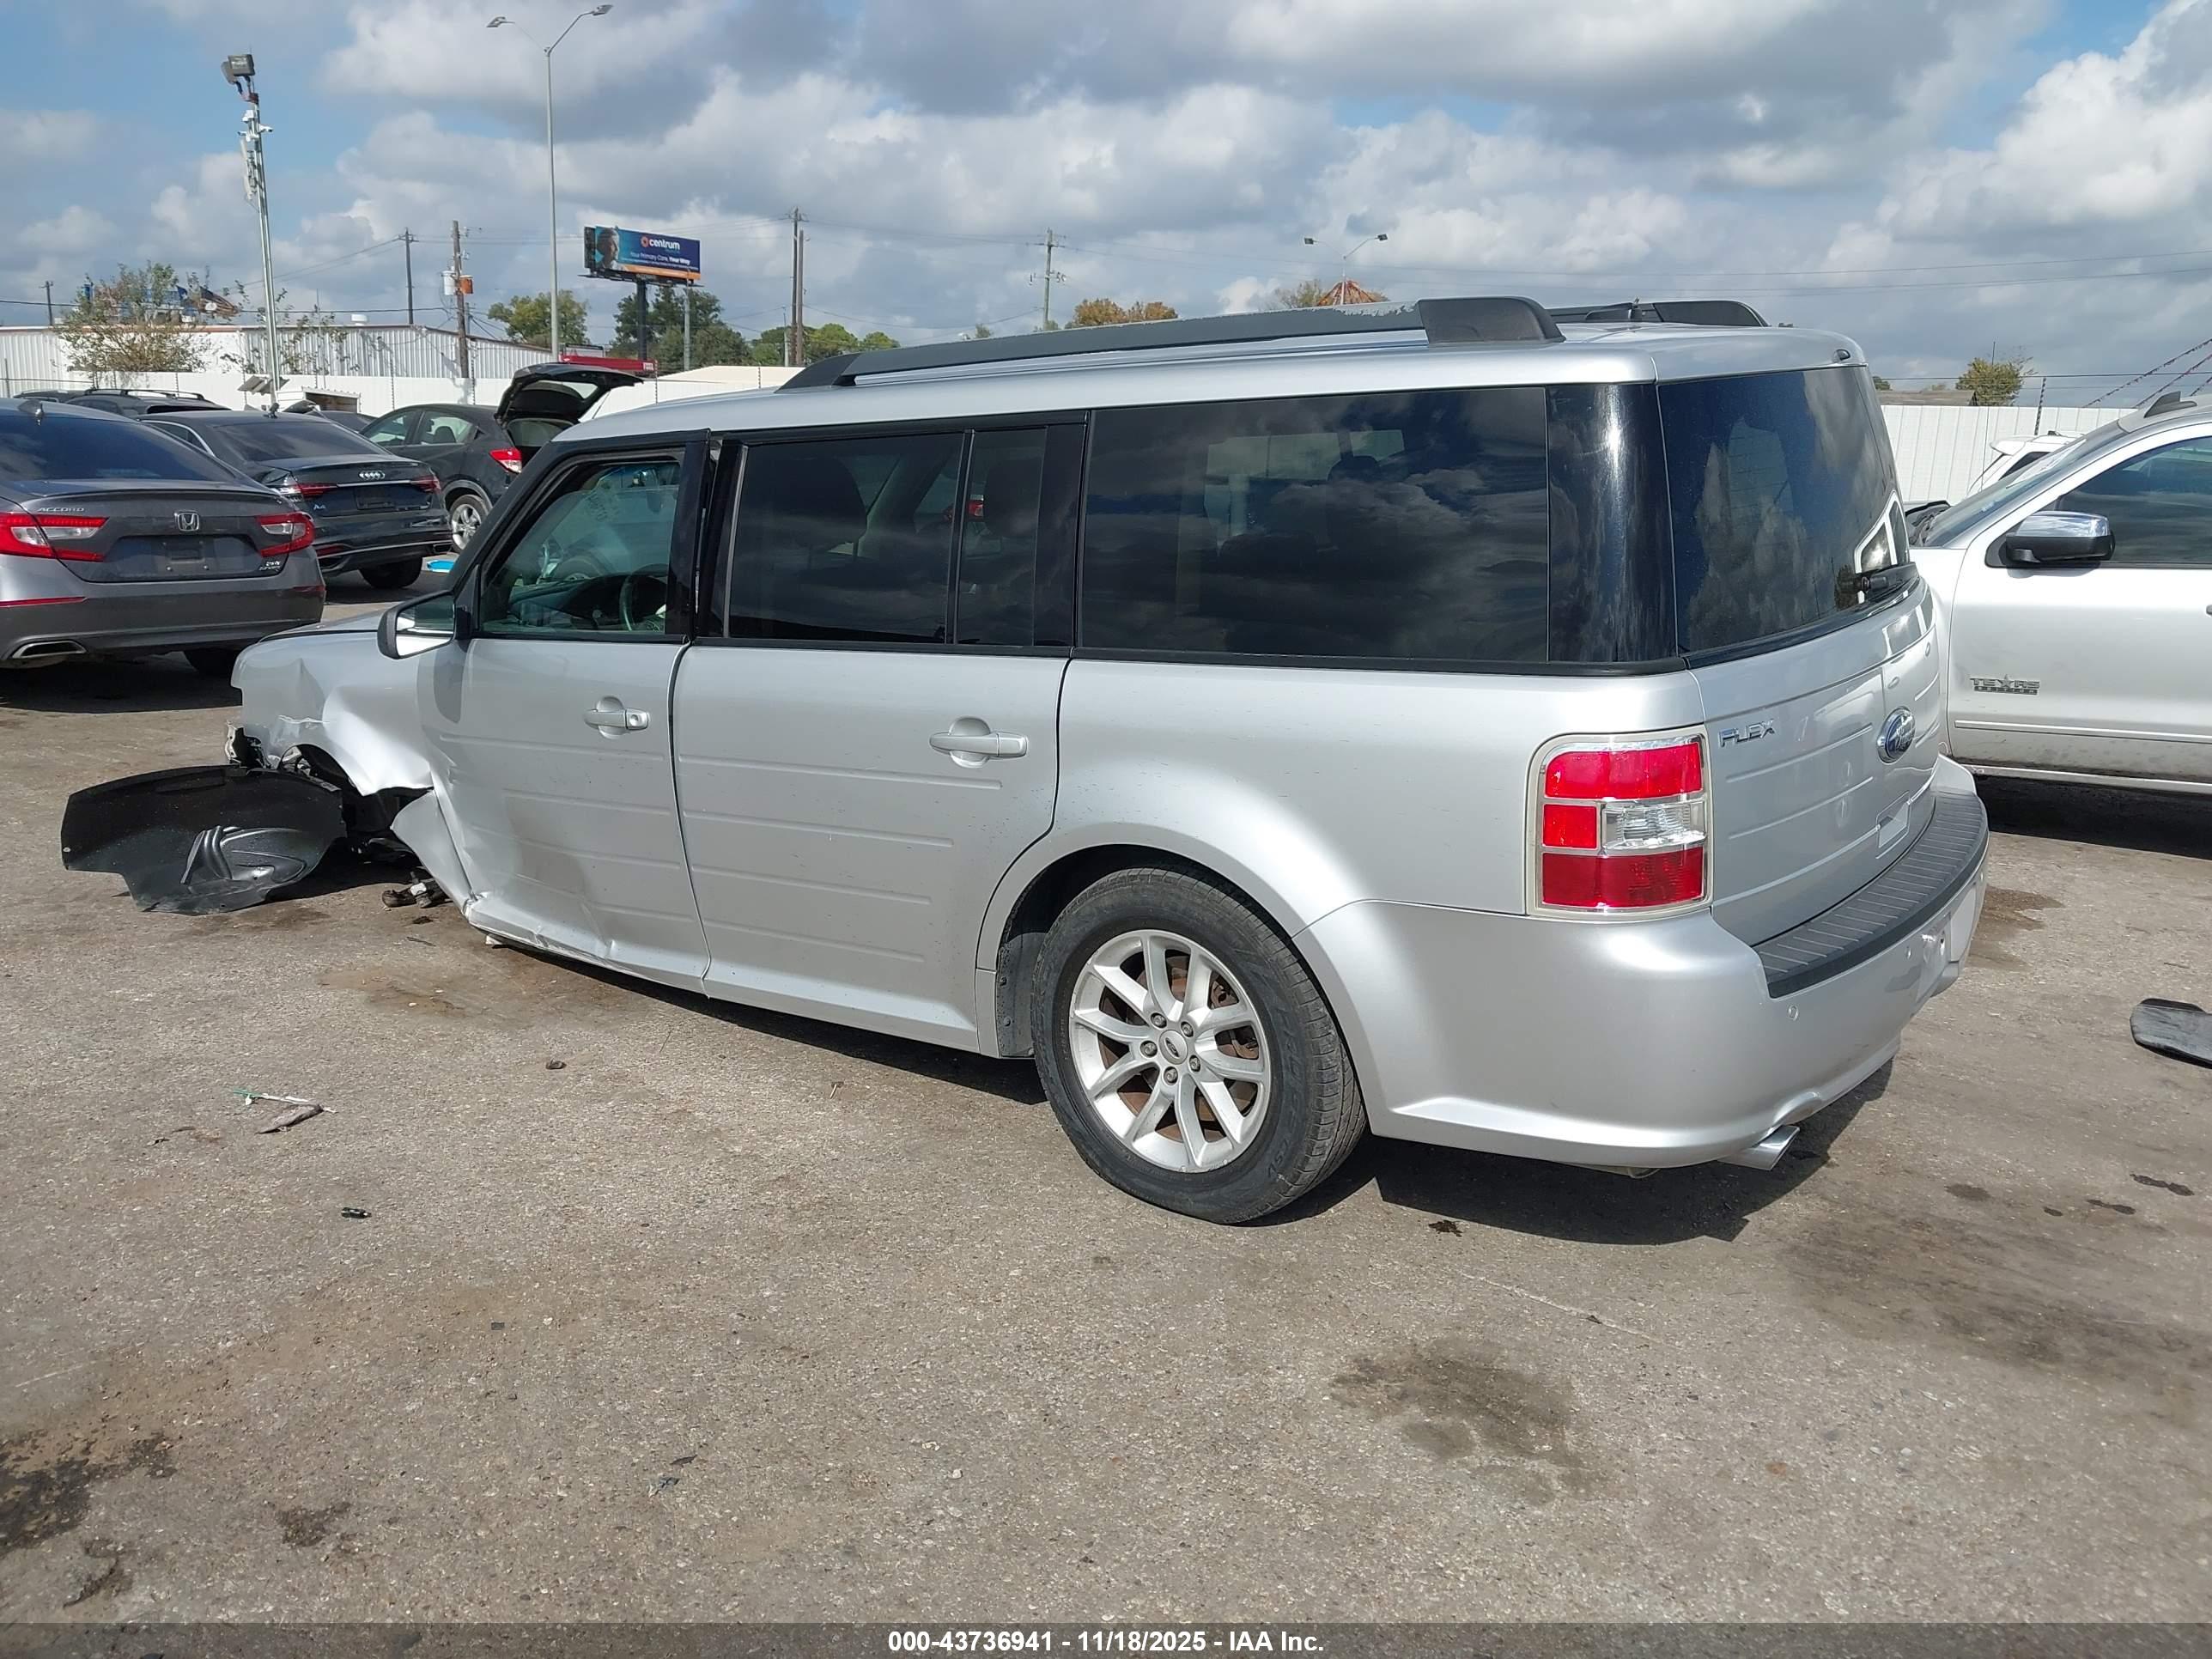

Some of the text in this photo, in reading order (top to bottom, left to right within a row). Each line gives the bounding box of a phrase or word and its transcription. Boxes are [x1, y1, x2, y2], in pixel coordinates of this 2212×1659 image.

[649, 239, 680, 250] centrum
[1969, 674, 2040, 689] TEXAS
[1717, 720, 1775, 747] FLEX
